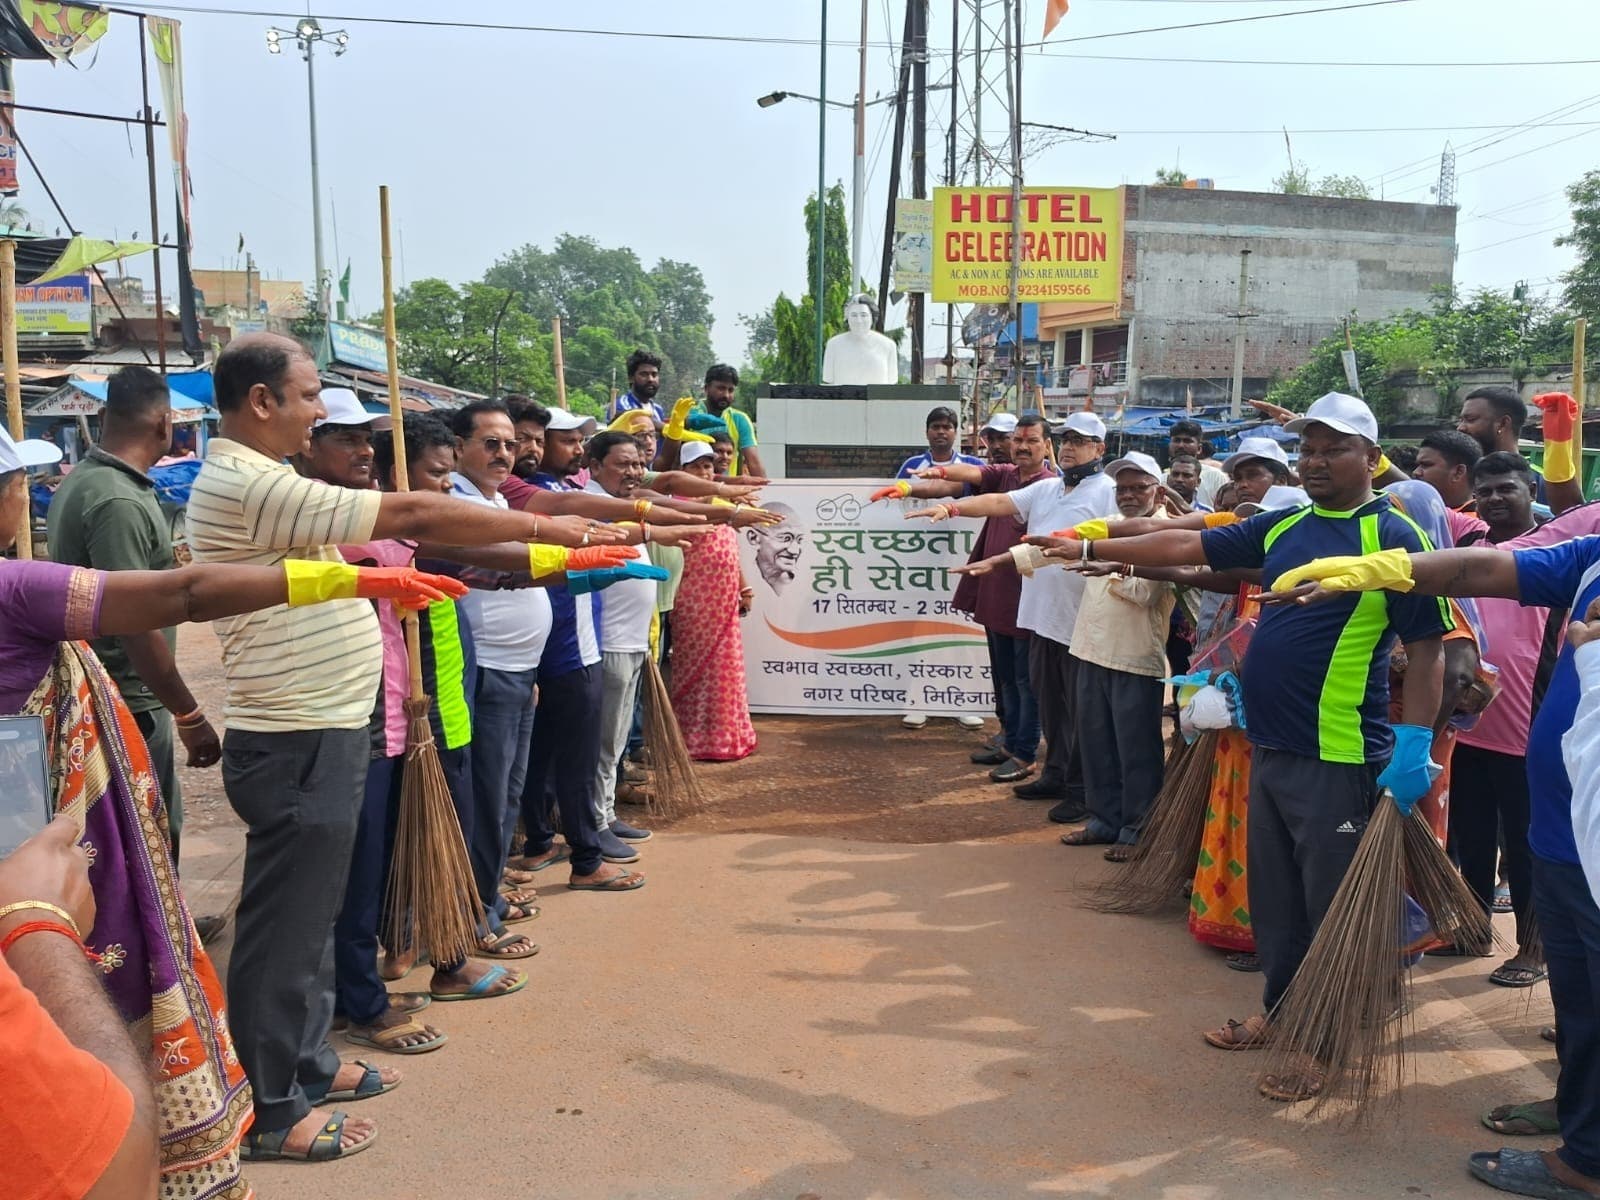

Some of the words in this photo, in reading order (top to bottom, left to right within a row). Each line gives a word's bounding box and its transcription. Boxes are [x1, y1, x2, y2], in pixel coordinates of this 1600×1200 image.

[951, 194, 1102, 222] HOTEL
[951, 269, 961, 279] AC
[963, 269, 968, 279] &
[971, 269, 989, 279] NON
[992, 269, 1001, 279] AC
[1005, 268, 1034, 279] ROMS
[1037, 268, 1052, 279] ARE
[1055, 268, 1099, 279] AVAILABLE
[38, 287, 84, 303] OPTICAL
[1018, 284, 1091, 296] 9234159566
[811, 530, 975, 554] स्वच्छता
[811, 555, 853, 593] ही
[868, 555, 953, 591] सेवा
[812, 600, 830, 614] 17
[837, 594, 896, 615] सितम्बर
[917, 600, 927, 615] 2
[763, 660, 818, 675] स्वभाव
[909, 659, 973, 679] संस्कार
[803, 688, 844, 702] नगर
